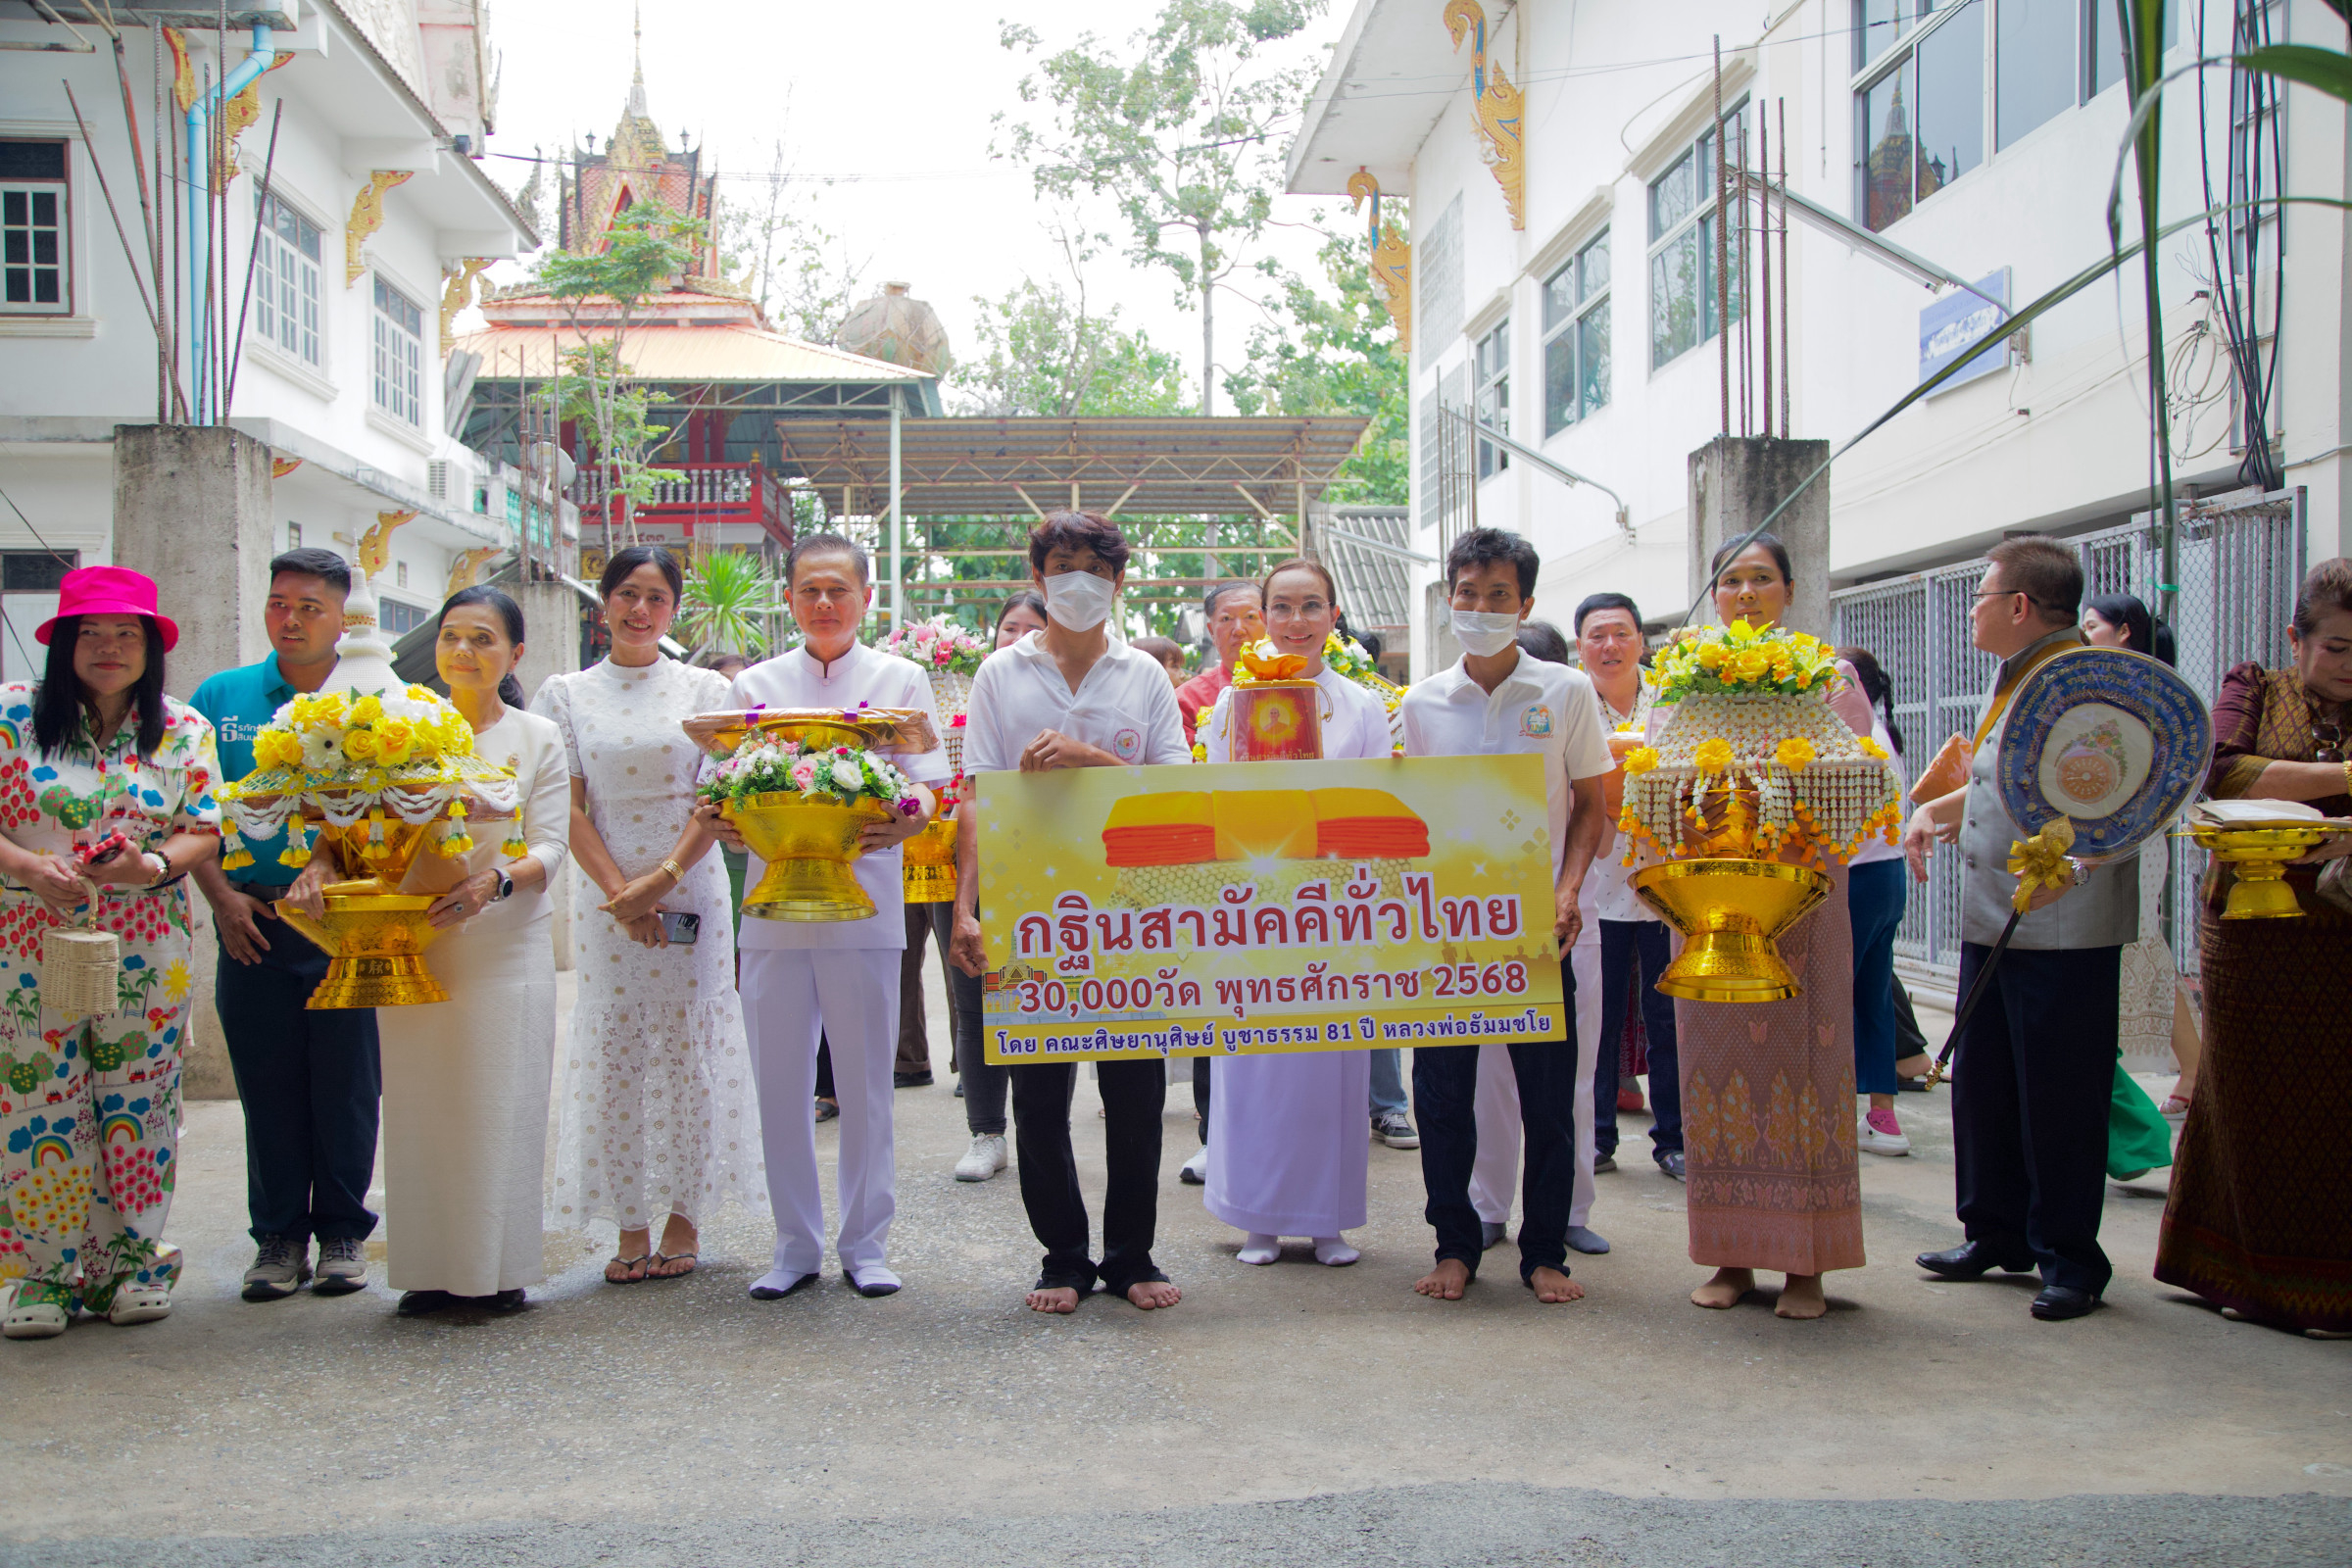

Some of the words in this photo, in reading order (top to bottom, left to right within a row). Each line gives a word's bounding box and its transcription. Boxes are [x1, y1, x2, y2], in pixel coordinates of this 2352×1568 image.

[1020, 867, 1521, 971] กฐินสามัคคีทั่วไทย
[1018, 969, 1201, 1017] 30,000วัด
[1215, 963, 1420, 1017] พุทธศักราช
[1434, 963, 1527, 996] 2568
[997, 1031, 1037, 1054] โดย
[1046, 1022, 1214, 1054] คณะศิษยานุศิษย์
[1222, 1027, 1319, 1052] บูชาธรรม
[1327, 1024, 1352, 1041] 81
[1359, 1017, 1375, 1039] ปี
[1383, 1009, 1551, 1039] หลวงพ่อธัมมชโย
